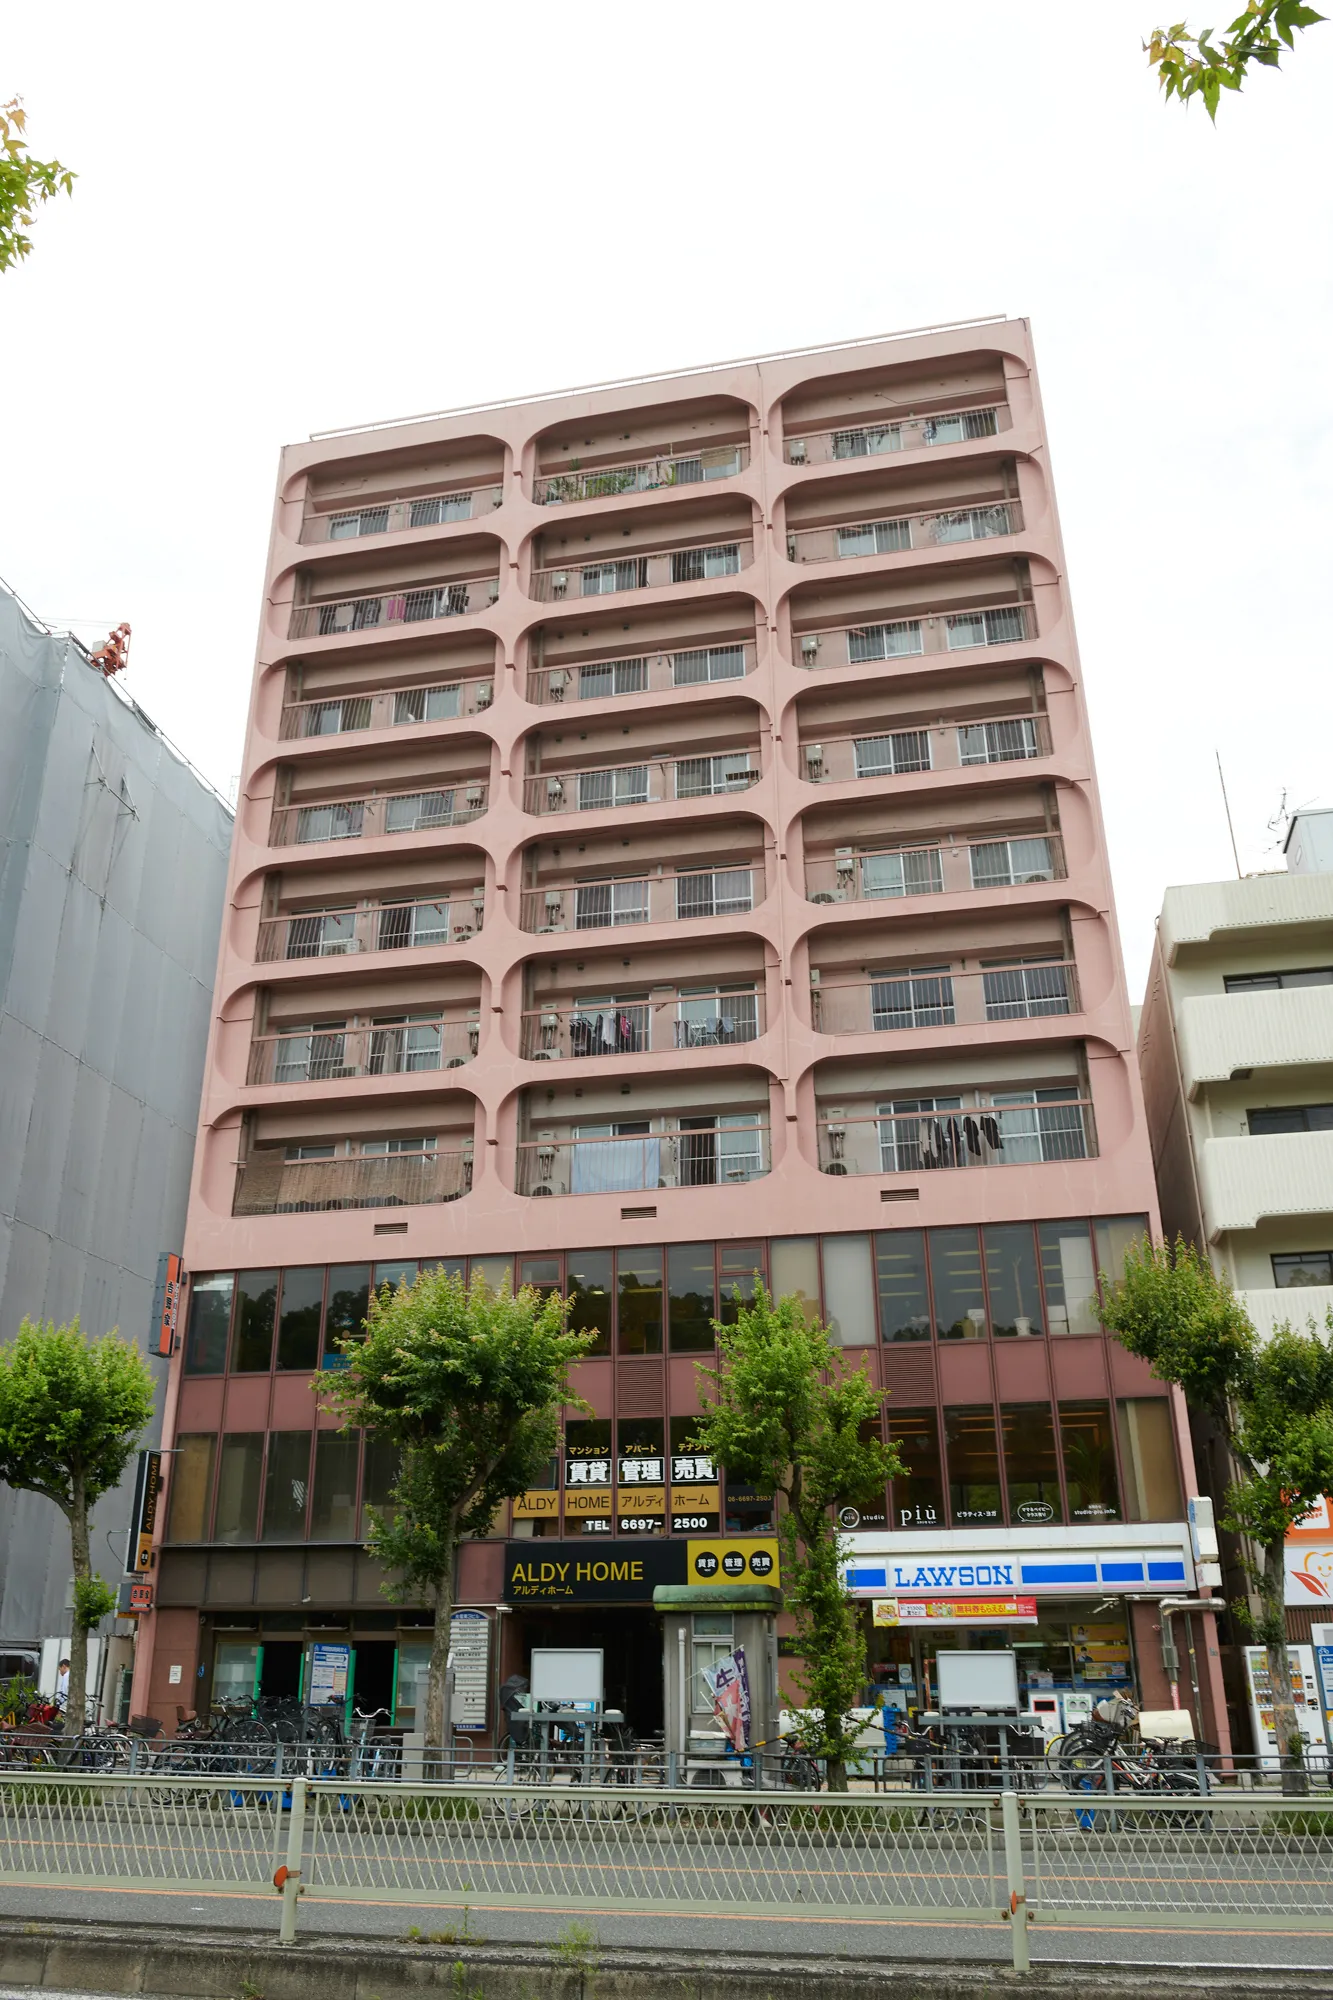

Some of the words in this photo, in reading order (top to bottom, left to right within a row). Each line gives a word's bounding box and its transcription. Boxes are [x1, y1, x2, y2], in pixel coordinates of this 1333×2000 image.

[568, 1446, 609, 1455] マンション
[625, 1444, 657, 1454] アパート
[678, 1443, 710, 1452] テナント
[569, 1461, 608, 1483] 賃貸
[621, 1460, 662, 1482] 管理
[674, 1458, 715, 1480] 売買
[517, 1498, 557, 1511] ALDY
[567, 1496, 610, 1509] HOME
[621, 1494, 664, 1508] アルディ
[674, 1493, 710, 1506] ホーム
[901, 1505, 937, 1526] più
[586, 1520, 610, 1531] TEL
[621, 1519, 662, 1530] 6697-
[674, 1517, 708, 1529] 2500
[698, 1558, 716, 1568] 賃貸
[724, 1557, 743, 1567] 管理
[752, 1557, 771, 1567] 売買
[511, 1562, 570, 1582] ALDY
[576, 1561, 644, 1581] HOME
[894, 1565, 1014, 1587] LAWSON
[513, 1585, 574, 1595] アルディホーム
